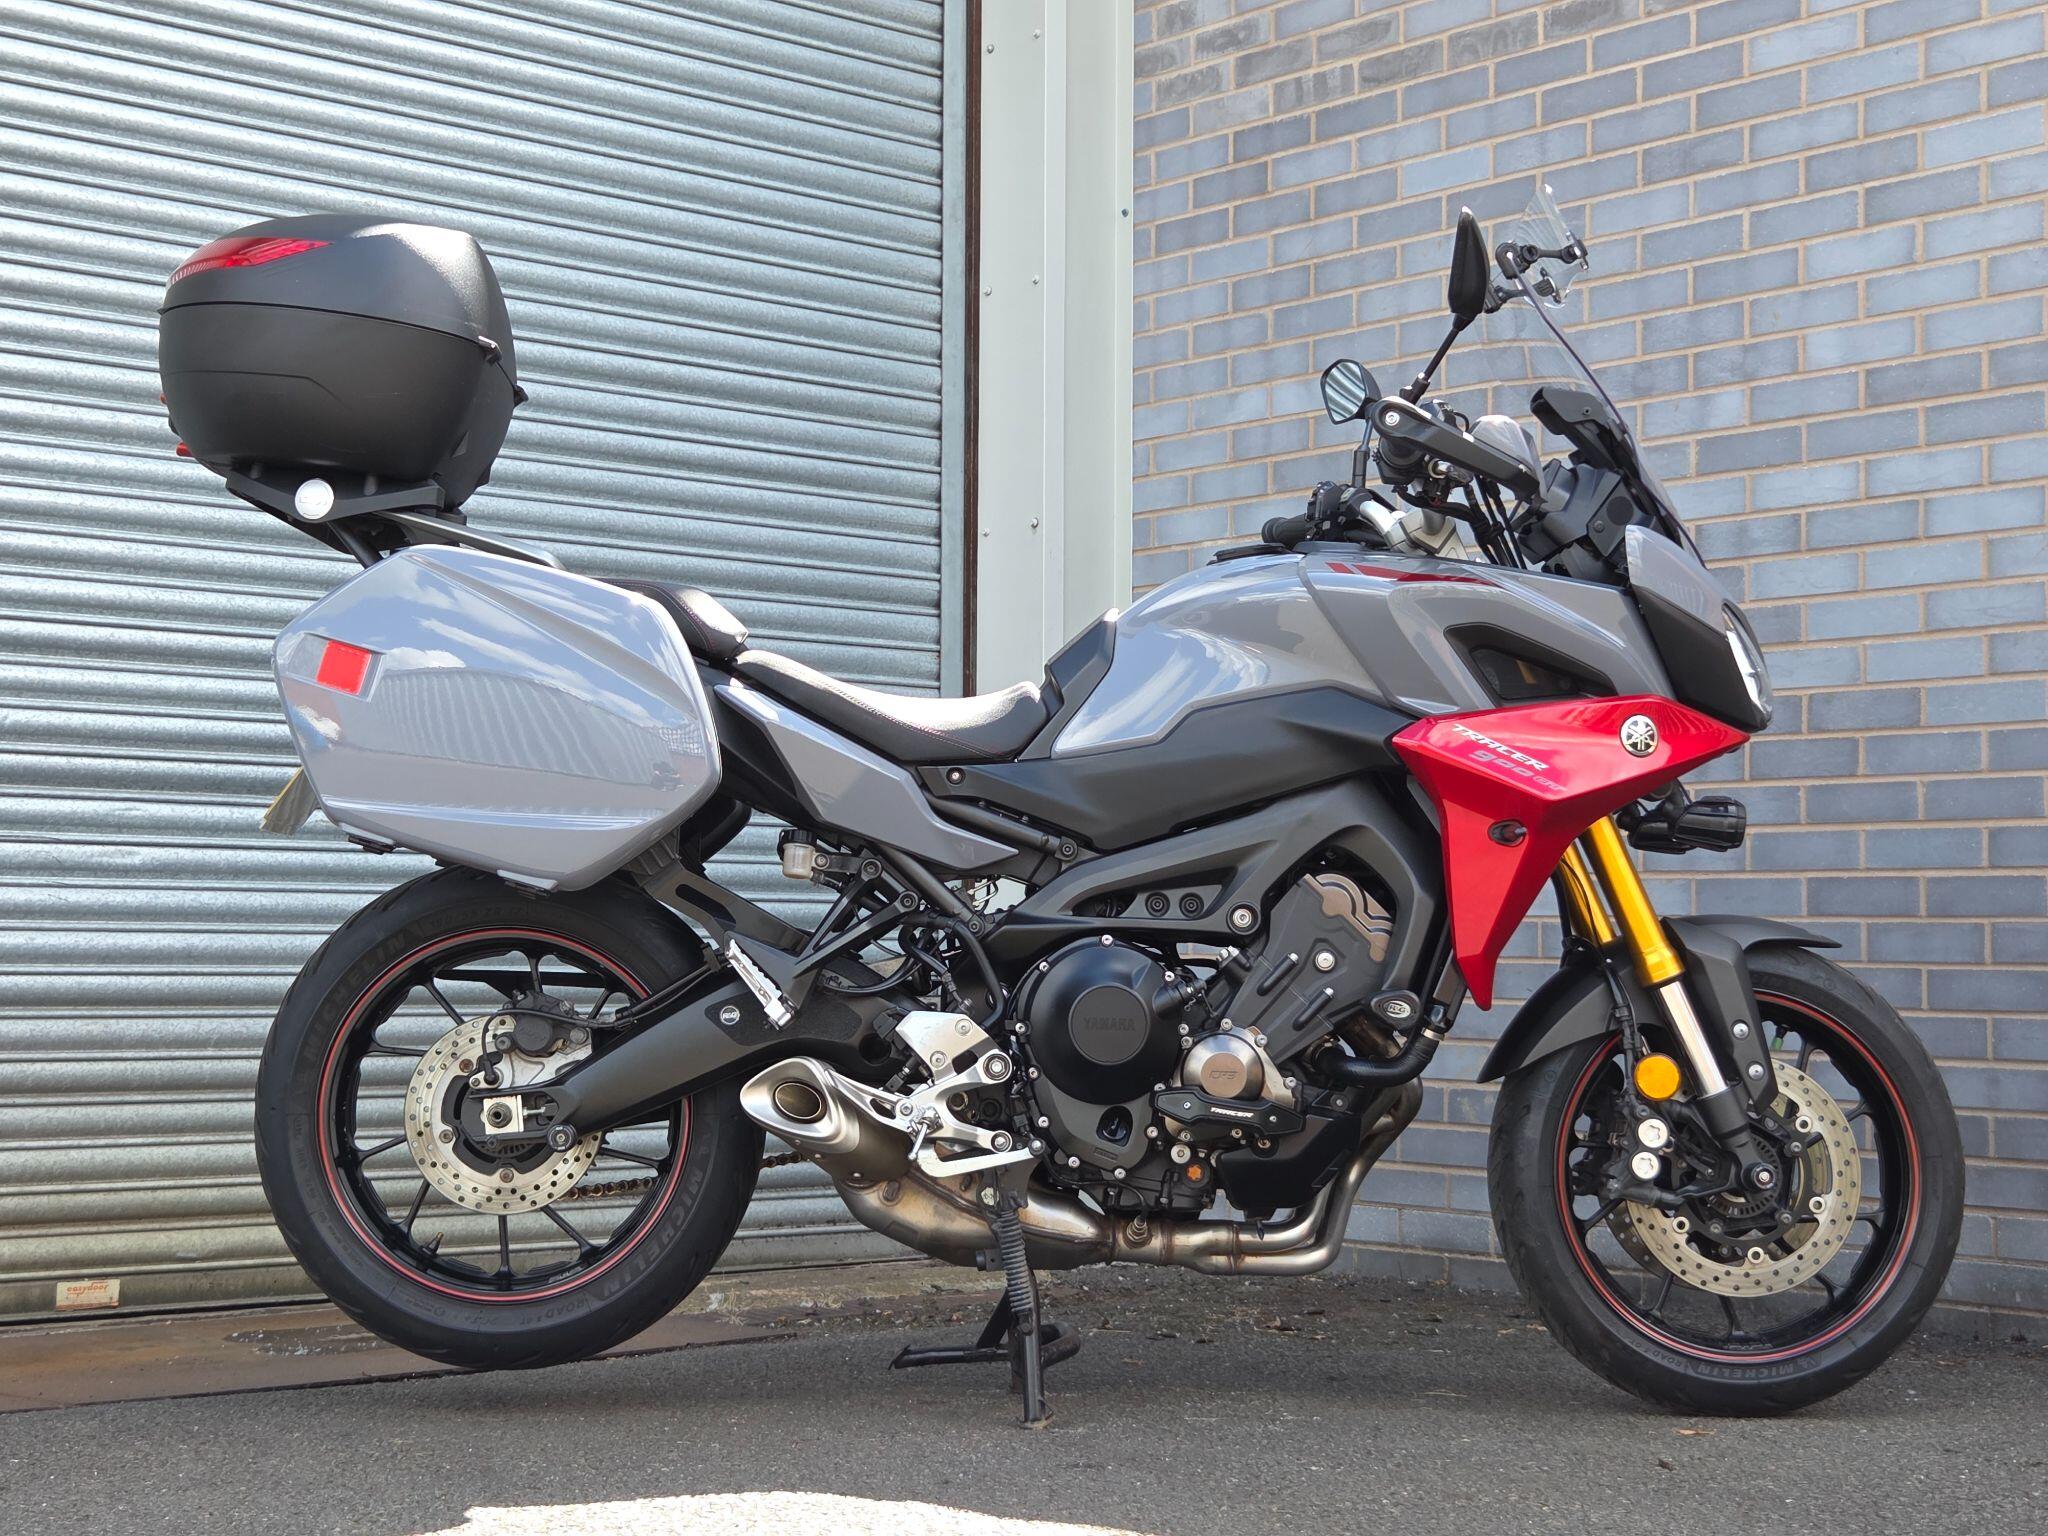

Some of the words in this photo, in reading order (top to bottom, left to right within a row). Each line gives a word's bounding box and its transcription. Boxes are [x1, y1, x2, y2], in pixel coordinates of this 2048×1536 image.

[1451, 723, 1549, 771] TRACER
[1469, 750, 1535, 777] 900
[1082, 1016, 1137, 1031] YAMAHA
[602, 1165, 703, 1297] MICHELIN
[544, 1300, 586, 1319] ROAD
[1652, 1350, 1682, 1367] ROAD
[1697, 1362, 1795, 1379] MICHELIN
